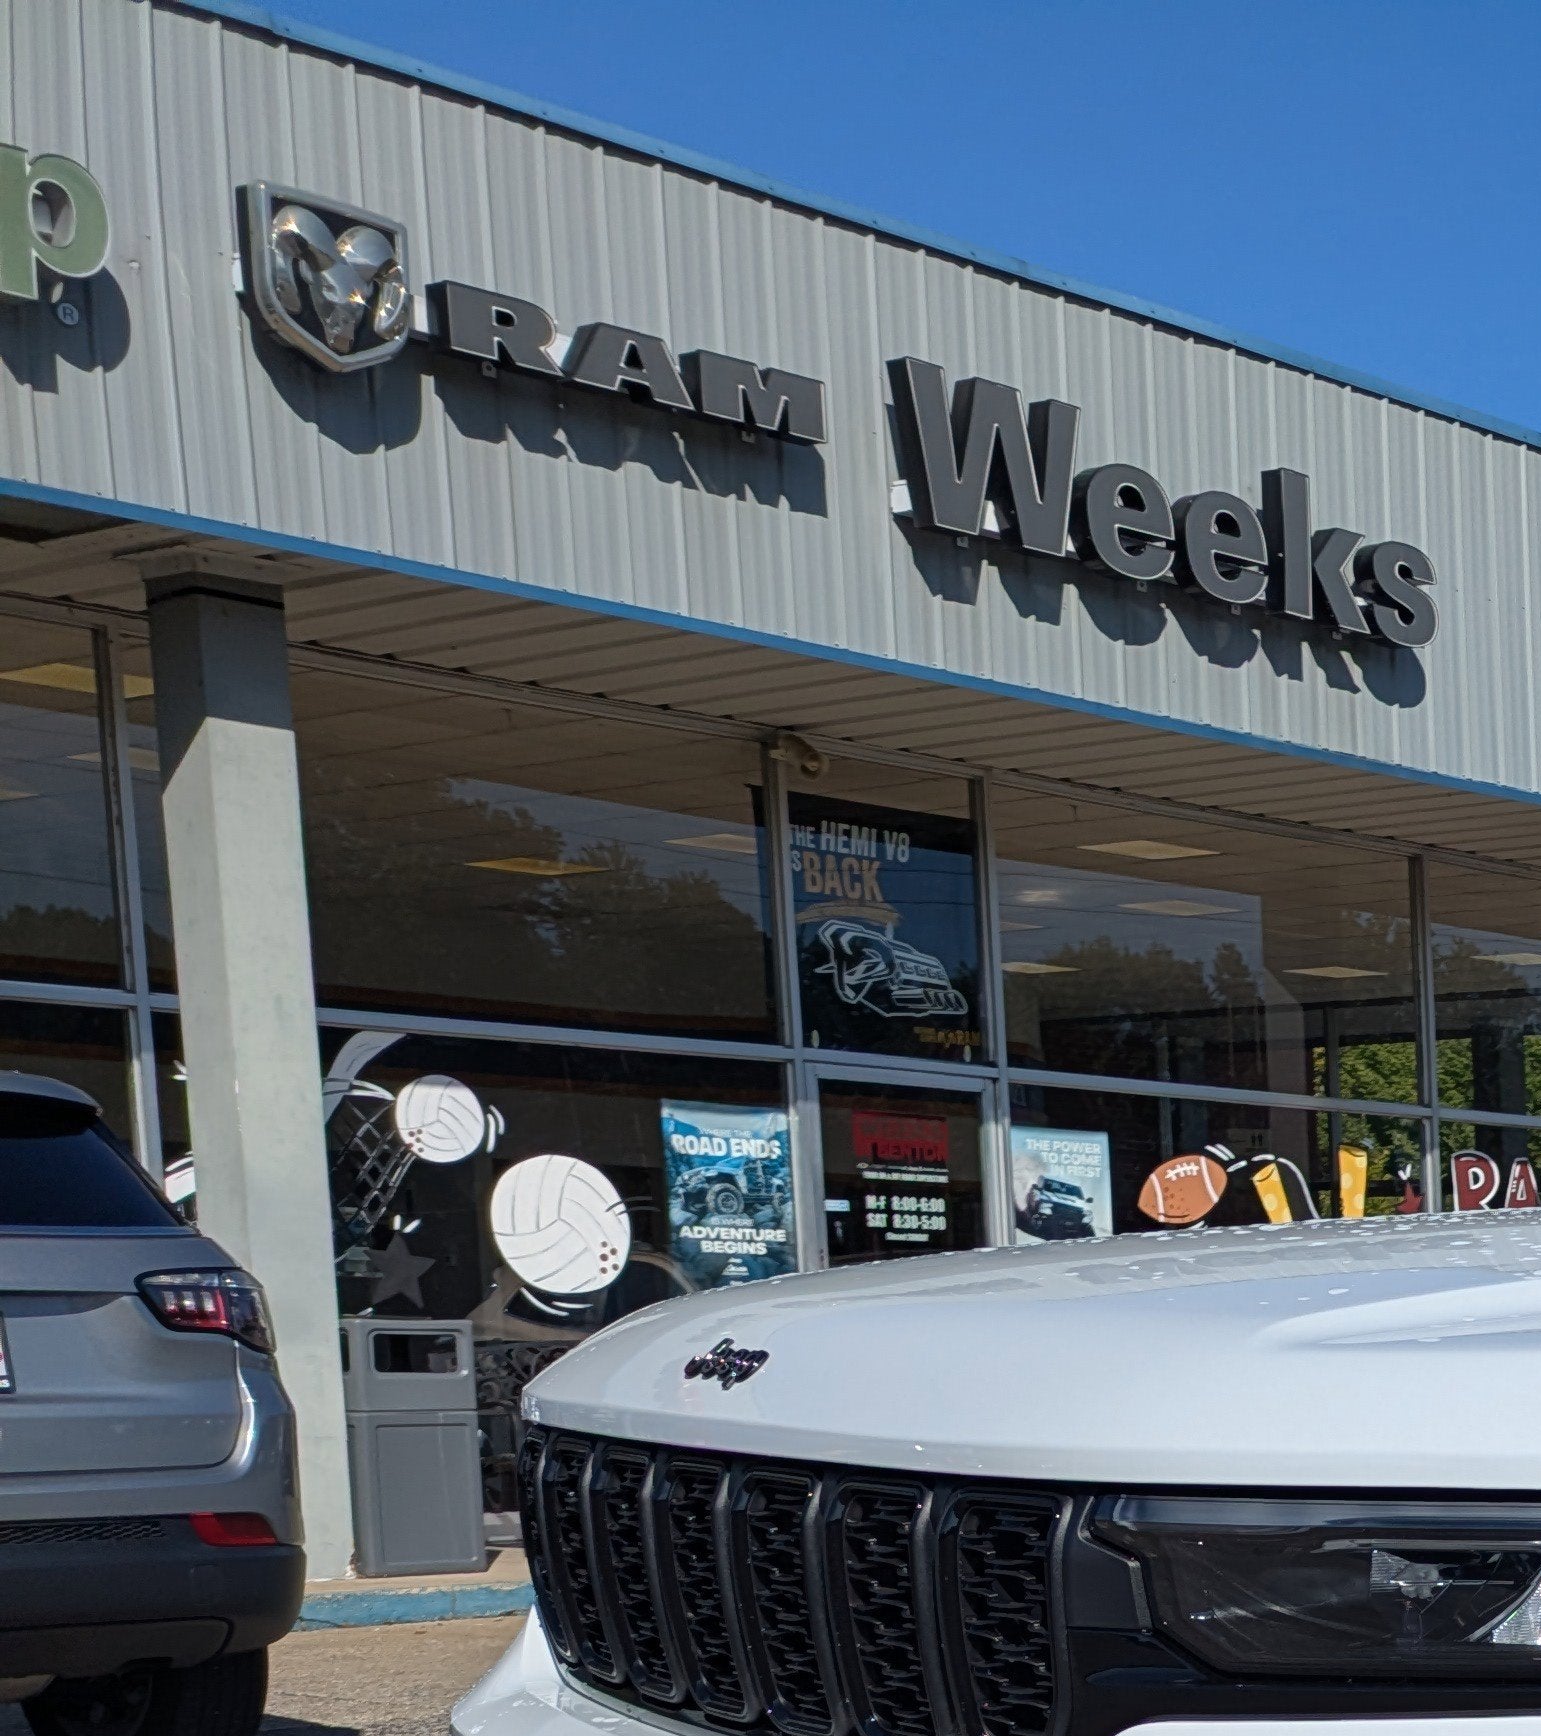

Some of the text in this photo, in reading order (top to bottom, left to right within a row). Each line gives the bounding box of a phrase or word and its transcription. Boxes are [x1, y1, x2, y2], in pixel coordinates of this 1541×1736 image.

[426, 280, 827, 443] RAM
[886, 356, 1438, 648] Weeks
[821, 819, 877, 858] HEMI
[882, 829, 910, 863] V8
[802, 851, 885, 902] BACK
[671, 1134, 782, 1159] ROAD ENDS
[1026, 1139, 1101, 1153] THE POWER
[1041, 1151, 1059, 1164] TO
[679, 1225, 787, 1242] ADVENTURE
[700, 1240, 768, 1255] BEGINS
